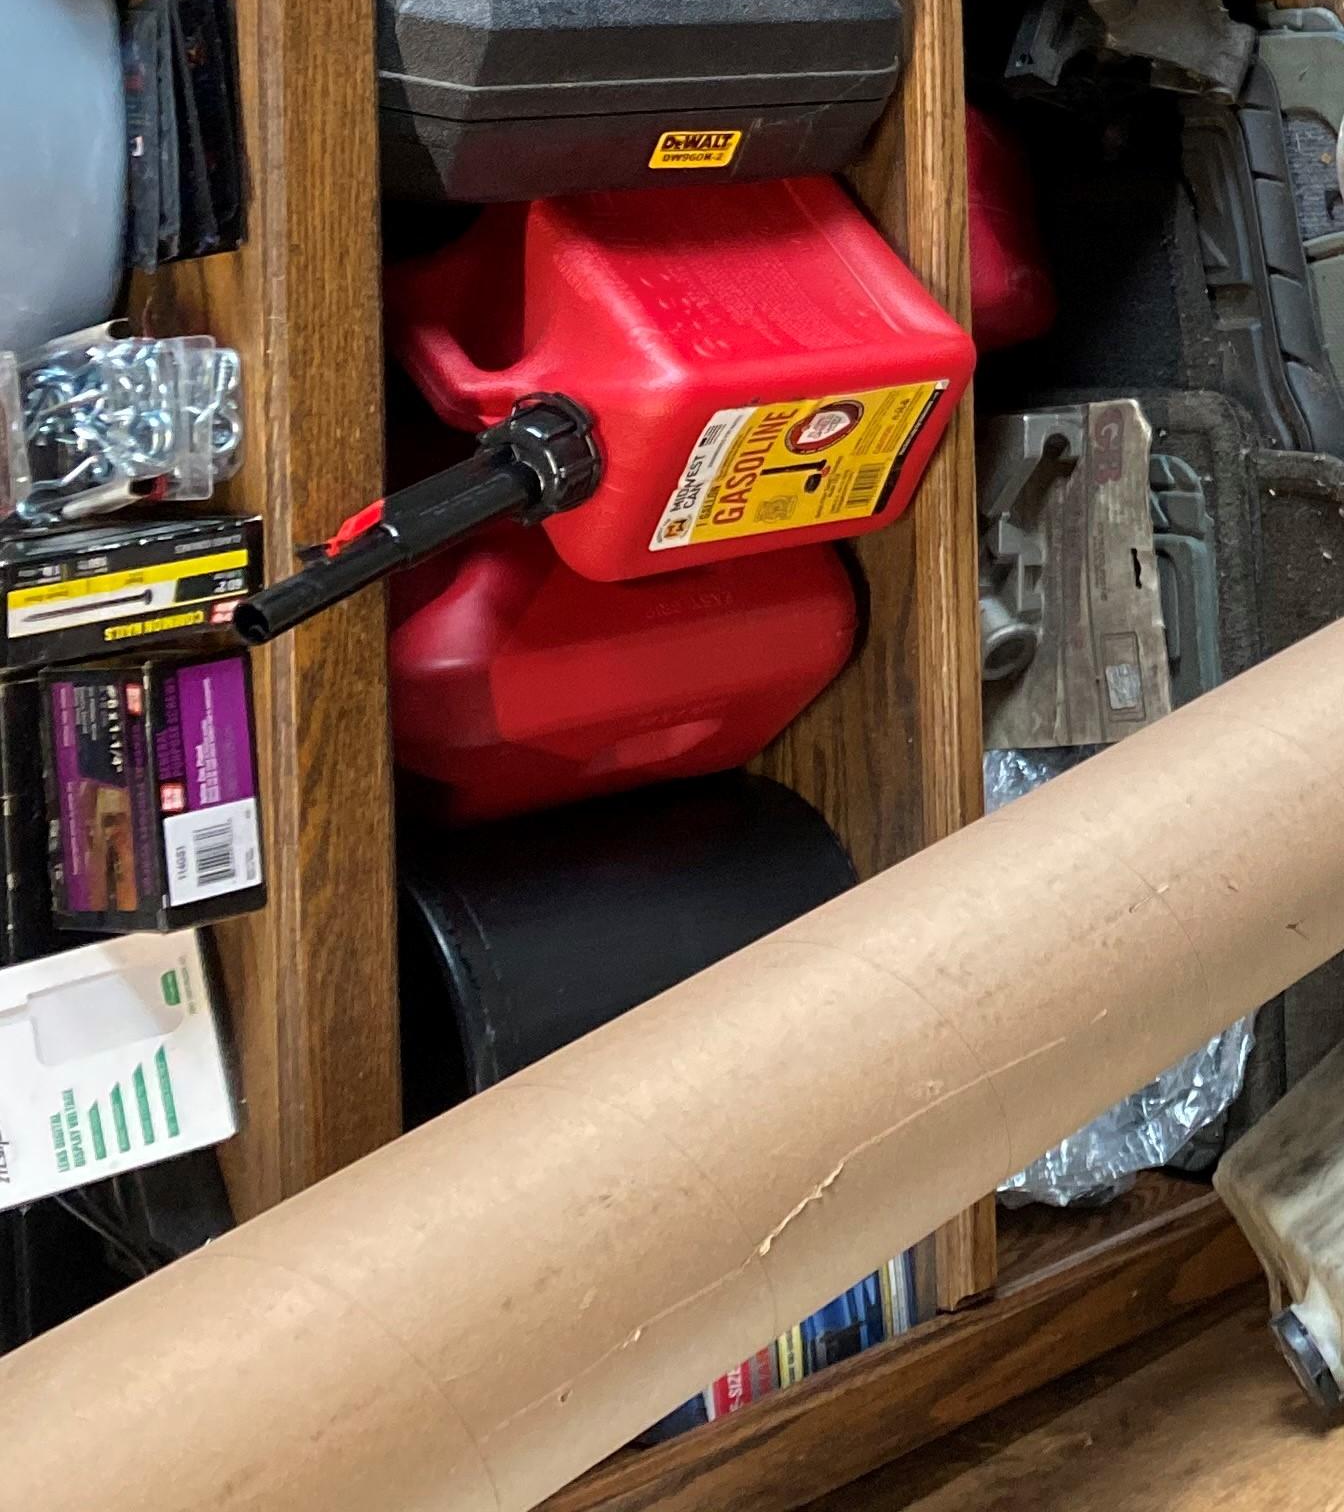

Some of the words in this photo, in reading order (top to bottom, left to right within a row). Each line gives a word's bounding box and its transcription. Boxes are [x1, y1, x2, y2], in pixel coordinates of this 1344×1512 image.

[670, 455, 706, 513] MIDWEST
[712, 408, 799, 526] GASOLINE
[683, 483, 705, 509] CAN
[70, 1130, 86, 1168] DISPLAY
